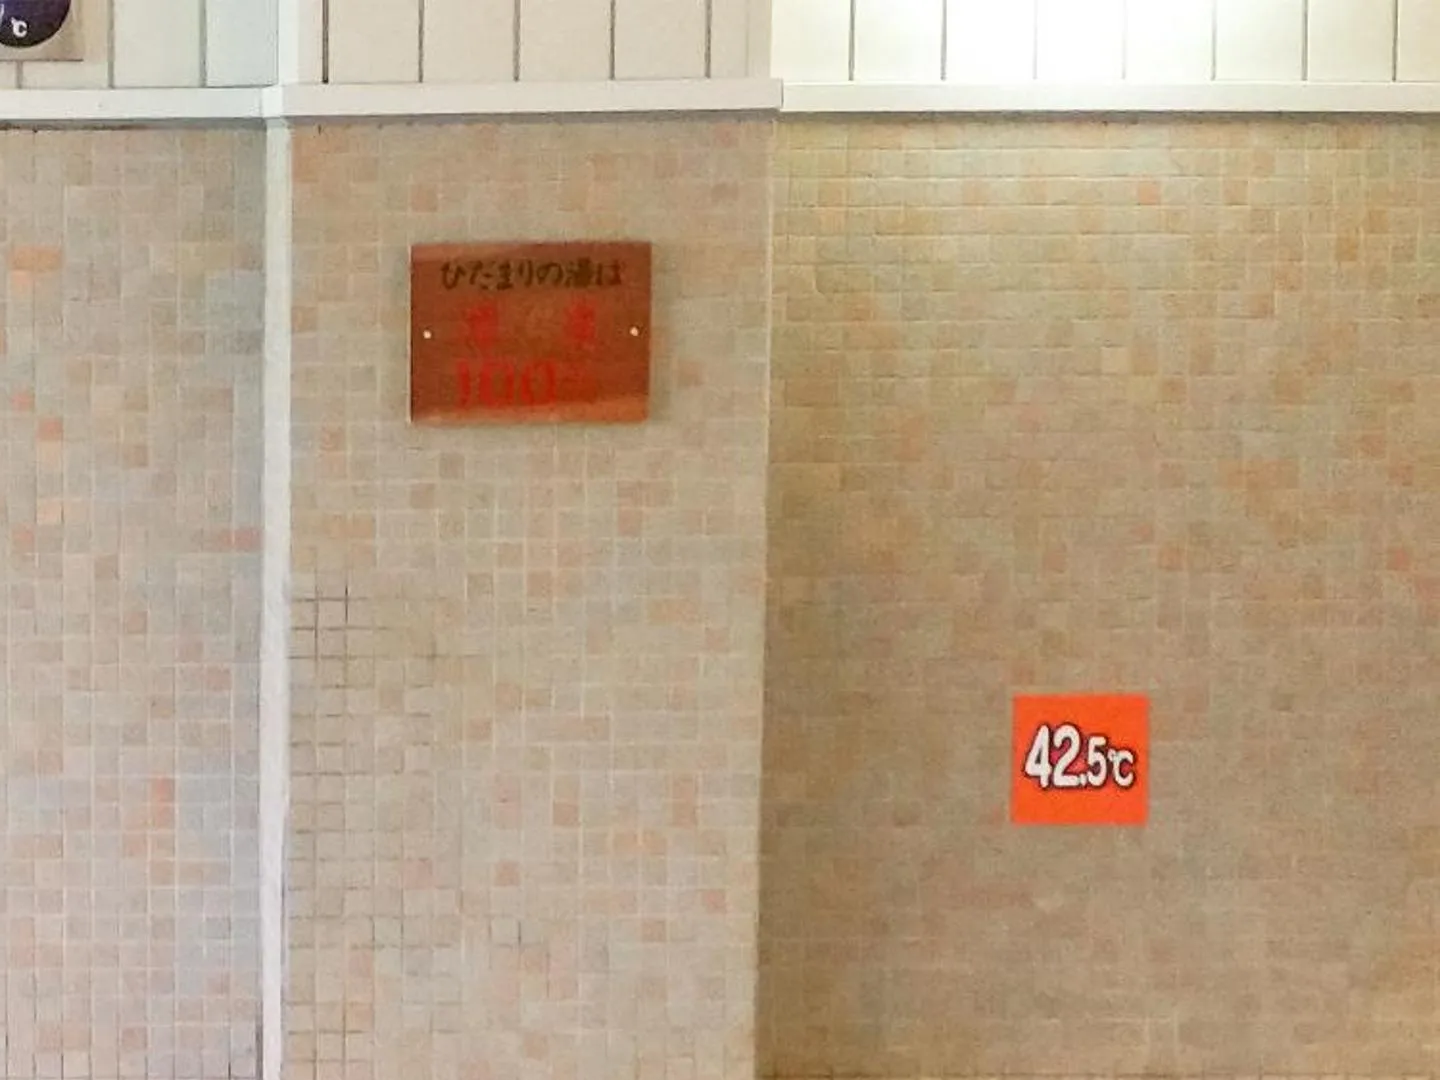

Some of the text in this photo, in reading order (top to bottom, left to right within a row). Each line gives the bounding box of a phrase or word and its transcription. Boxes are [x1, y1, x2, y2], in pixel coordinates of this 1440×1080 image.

[441, 257, 622, 290] ひだまりの湯は
[1024, 722, 1137, 790] 42.5℃
